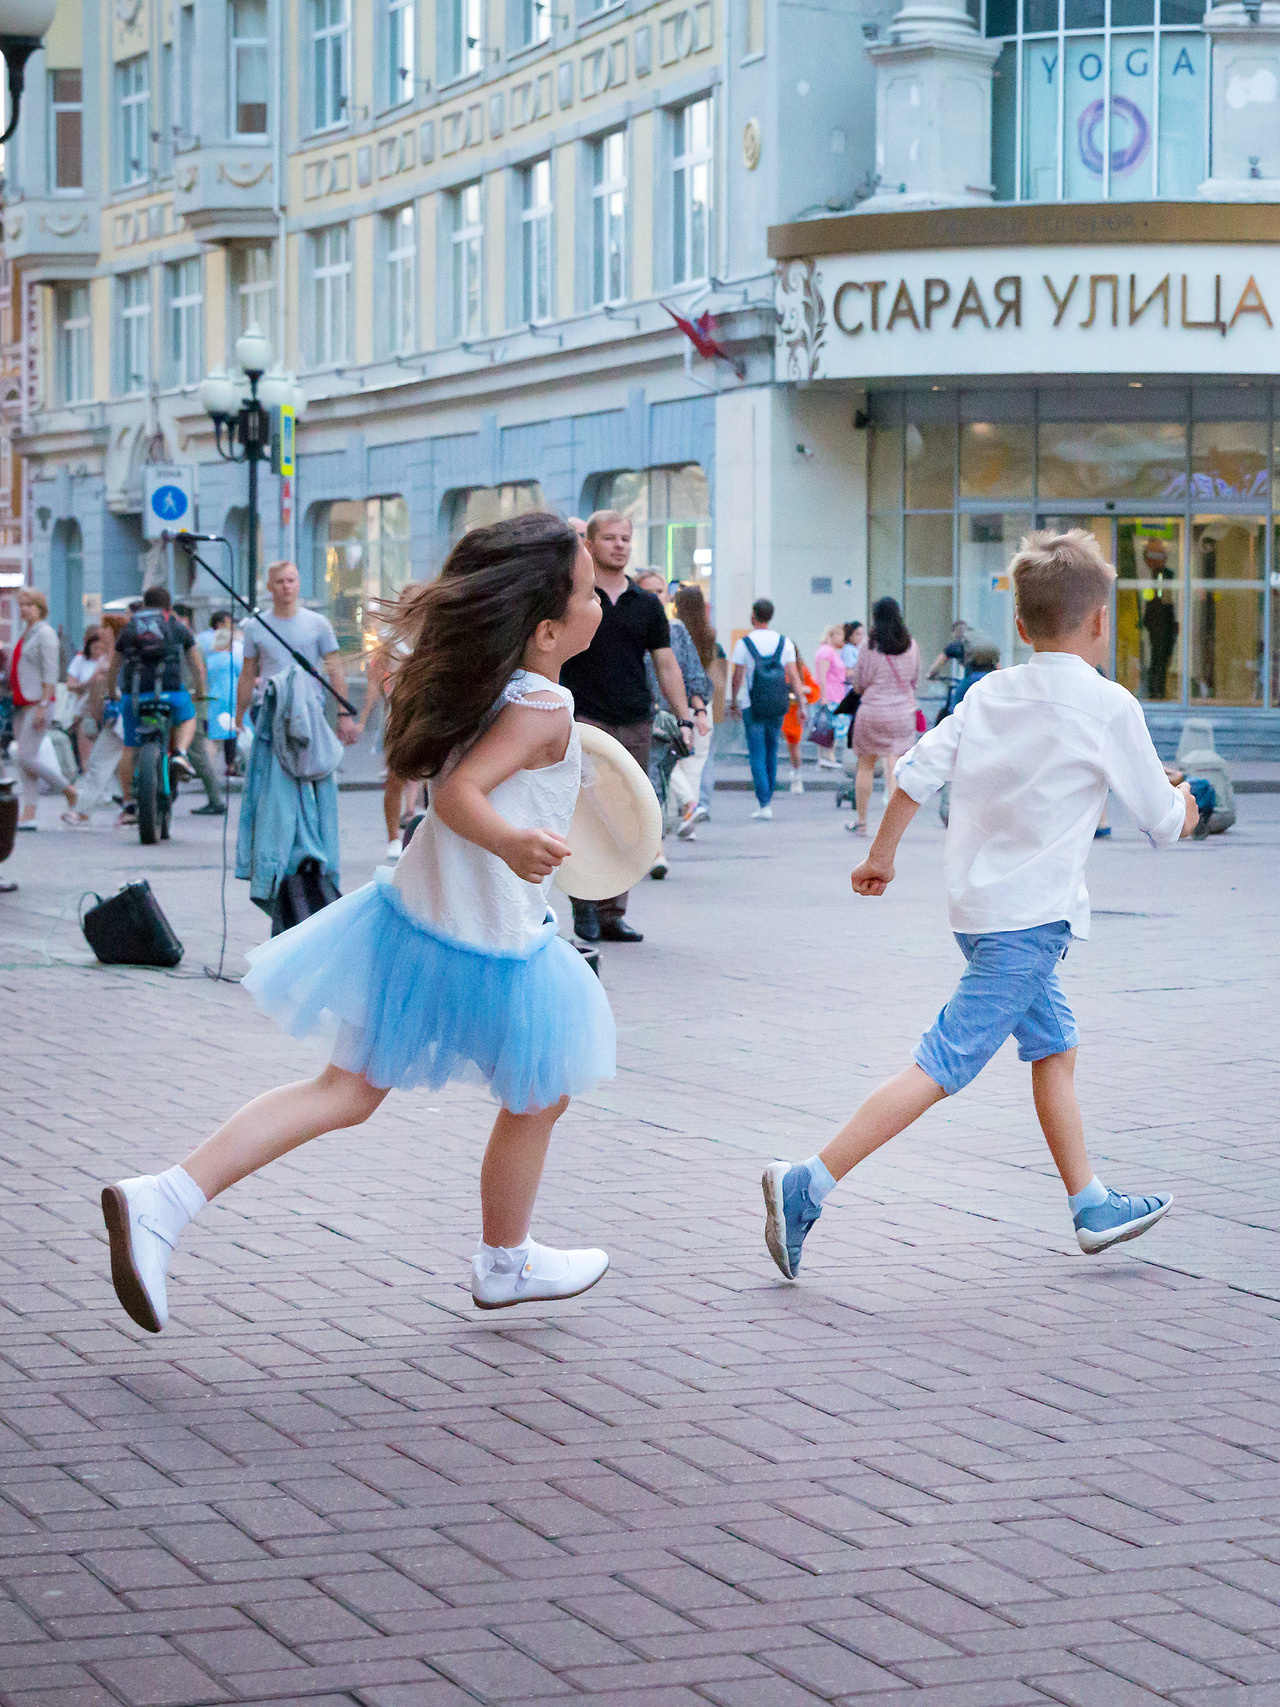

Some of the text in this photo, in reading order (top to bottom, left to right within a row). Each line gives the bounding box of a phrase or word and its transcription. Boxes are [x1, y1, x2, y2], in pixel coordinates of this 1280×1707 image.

[1041, 48, 1196, 84] YOGA
[833, 273, 1273, 337] СТАРАЯ УЛИЦА
